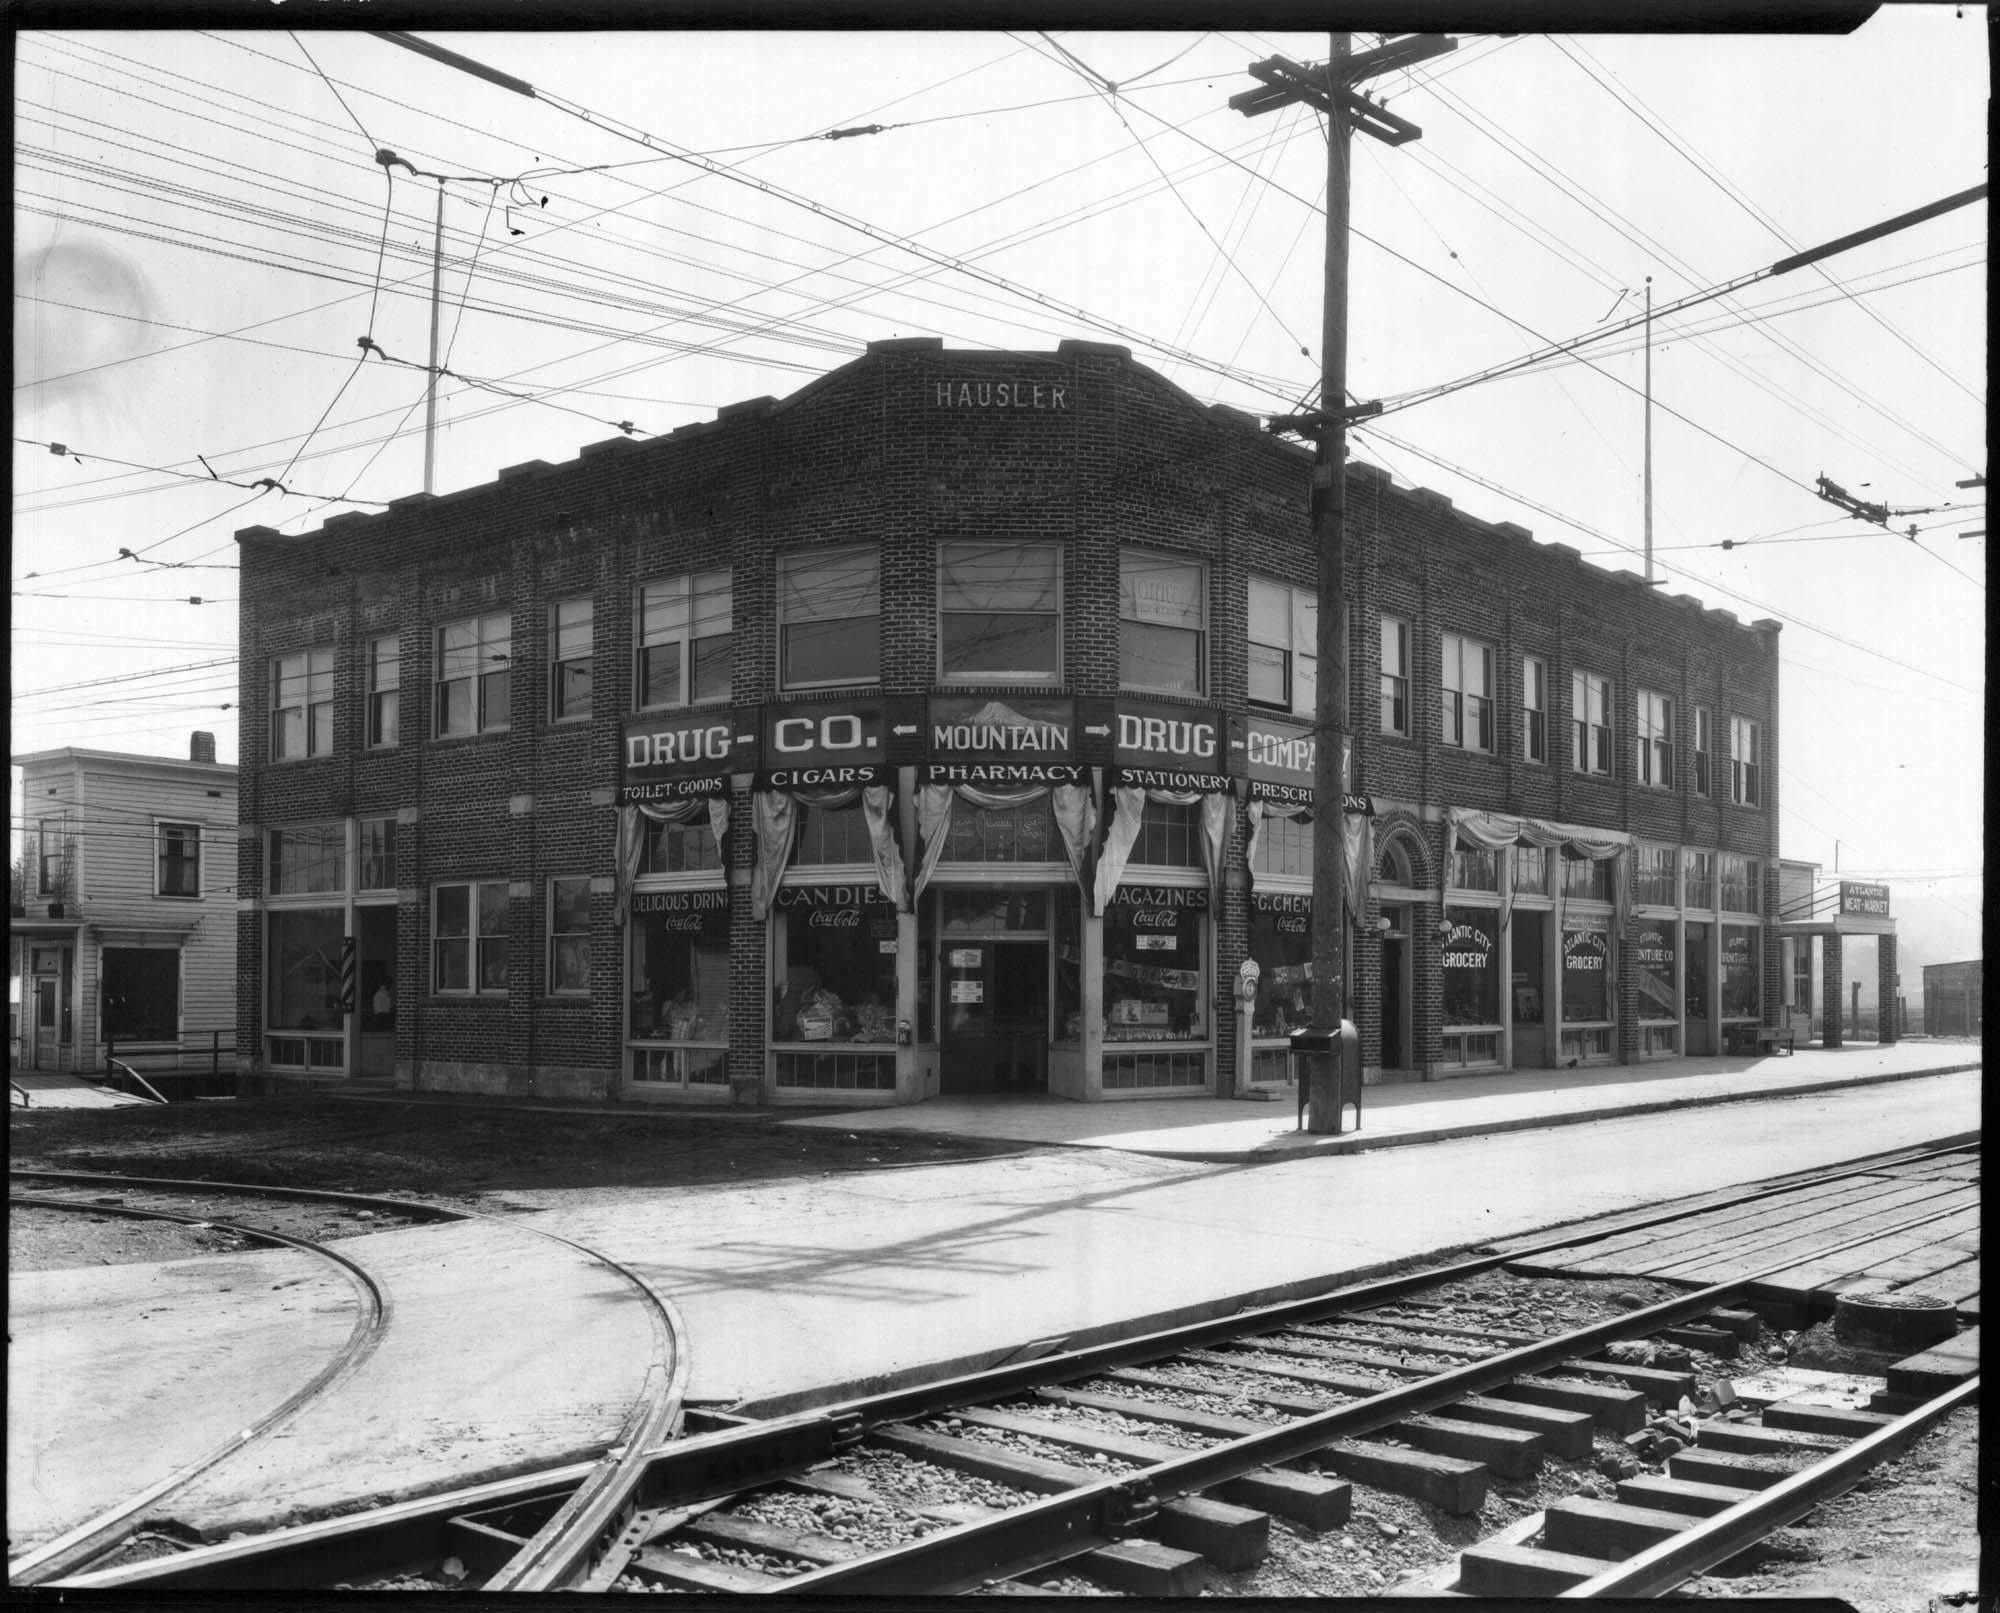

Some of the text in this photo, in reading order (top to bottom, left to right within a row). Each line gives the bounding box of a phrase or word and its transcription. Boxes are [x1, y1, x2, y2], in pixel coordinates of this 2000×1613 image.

[936, 382, 1065, 408] HAUSLER
[774, 715, 877, 752] CO.
[933, 725, 1069, 750] MOUNTAIN
[1117, 714, 1217, 757] DRUG
[627, 726, 732, 769] DRUG
[1247, 731, 1351, 779] COMPAY
[771, 766, 875, 786] CIGARS
[929, 765, 1083, 780] PHARMACY
[1121, 768, 1233, 790] STATIONERY
[623, 777, 723, 800] TOILET GOODS
[1252, 782, 1367, 810] PRESCRIONS
[632, 893, 689, 912] DELICIOUS
[1848, 885, 1884, 897] ATLANTIC
[1442, 925, 1493, 952] LANTIC CITY
[1564, 931, 1607, 956] ATLANTIC CITY
[1442, 952, 1488, 968] GROCERY
[1566, 955, 1603, 970] GROCERY
